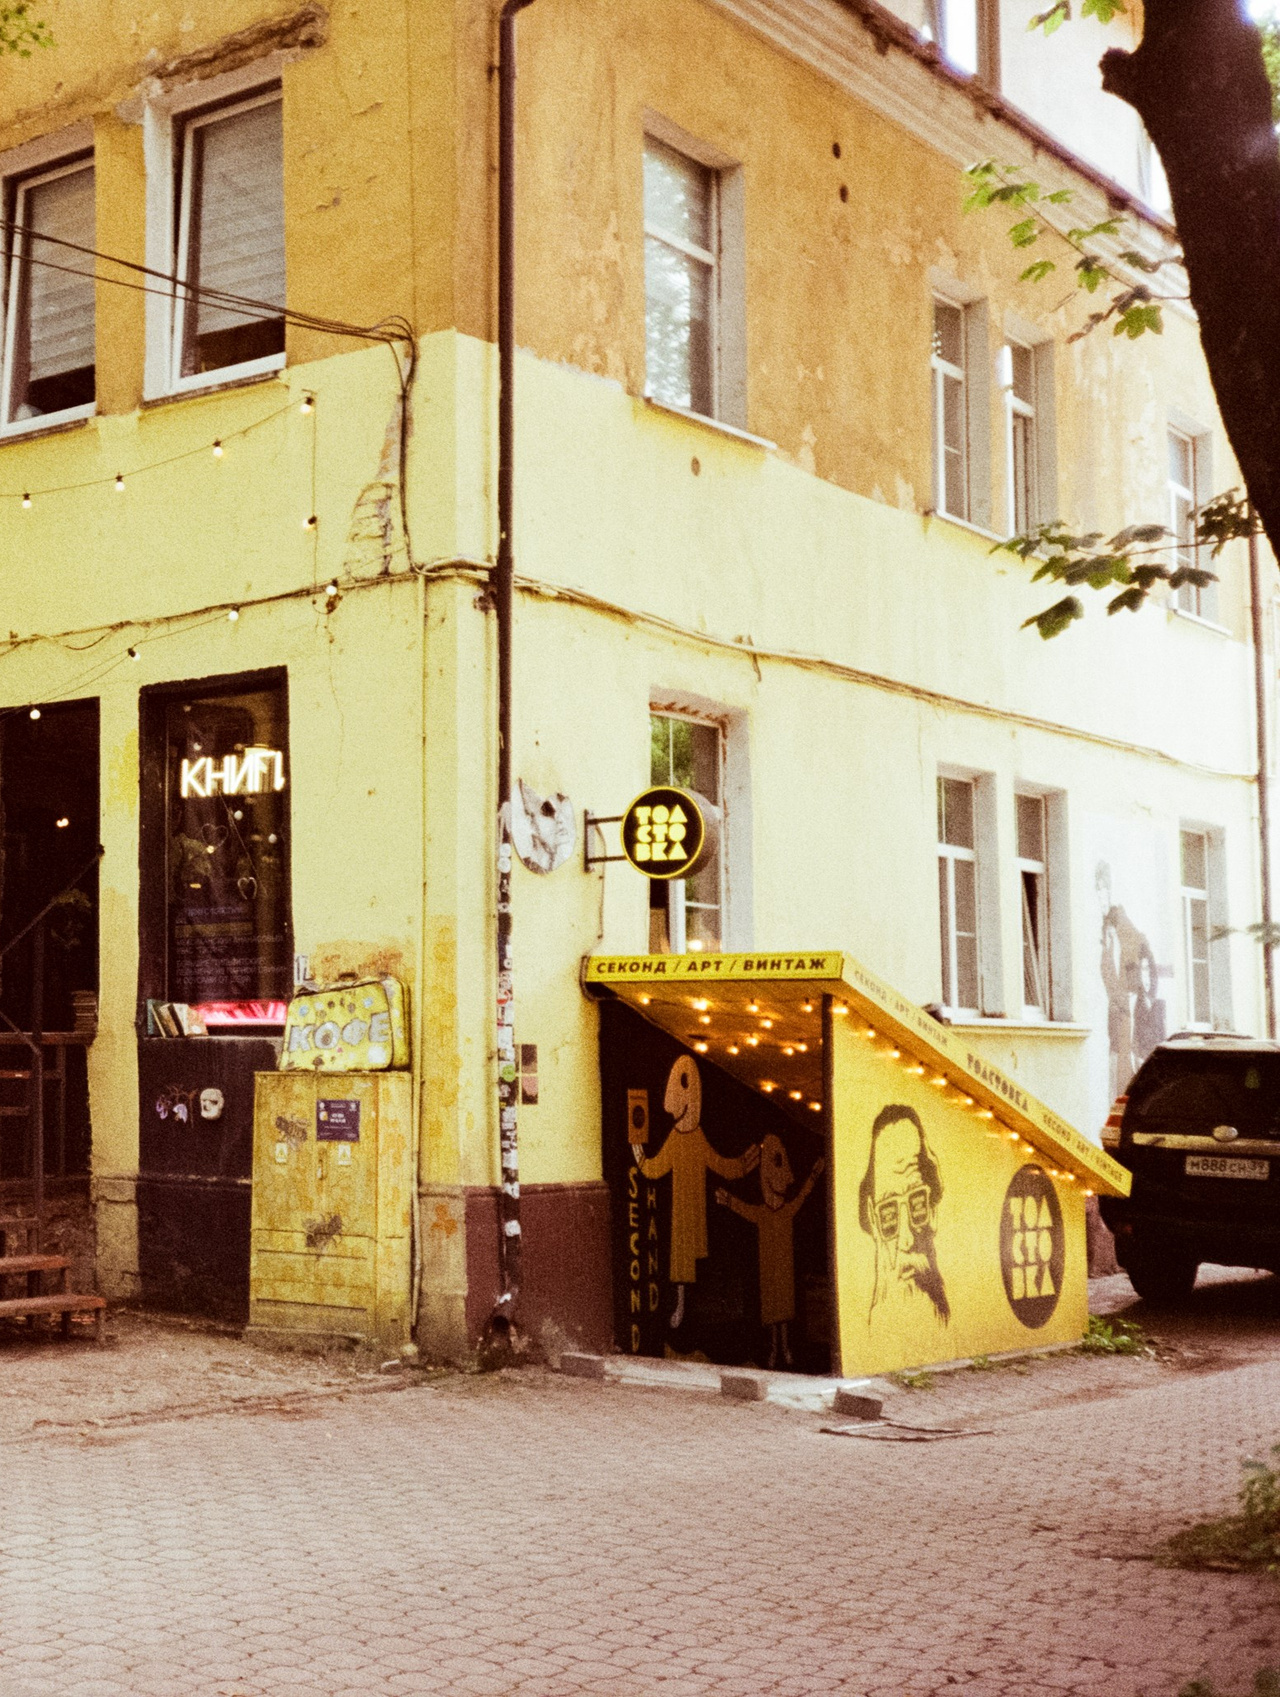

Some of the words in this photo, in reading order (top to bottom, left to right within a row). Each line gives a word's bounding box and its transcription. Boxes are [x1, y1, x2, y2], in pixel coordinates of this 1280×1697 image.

[596, 961, 667, 974] СЕКОНД
[687, 960, 723, 972] АРТ
[743, 957, 827, 971] ВИНТАЖ
[288, 1011, 389, 1053] КОФЕ
[628, 1166, 641, 1351] SECOND
[647, 1187, 659, 1312] HAND
